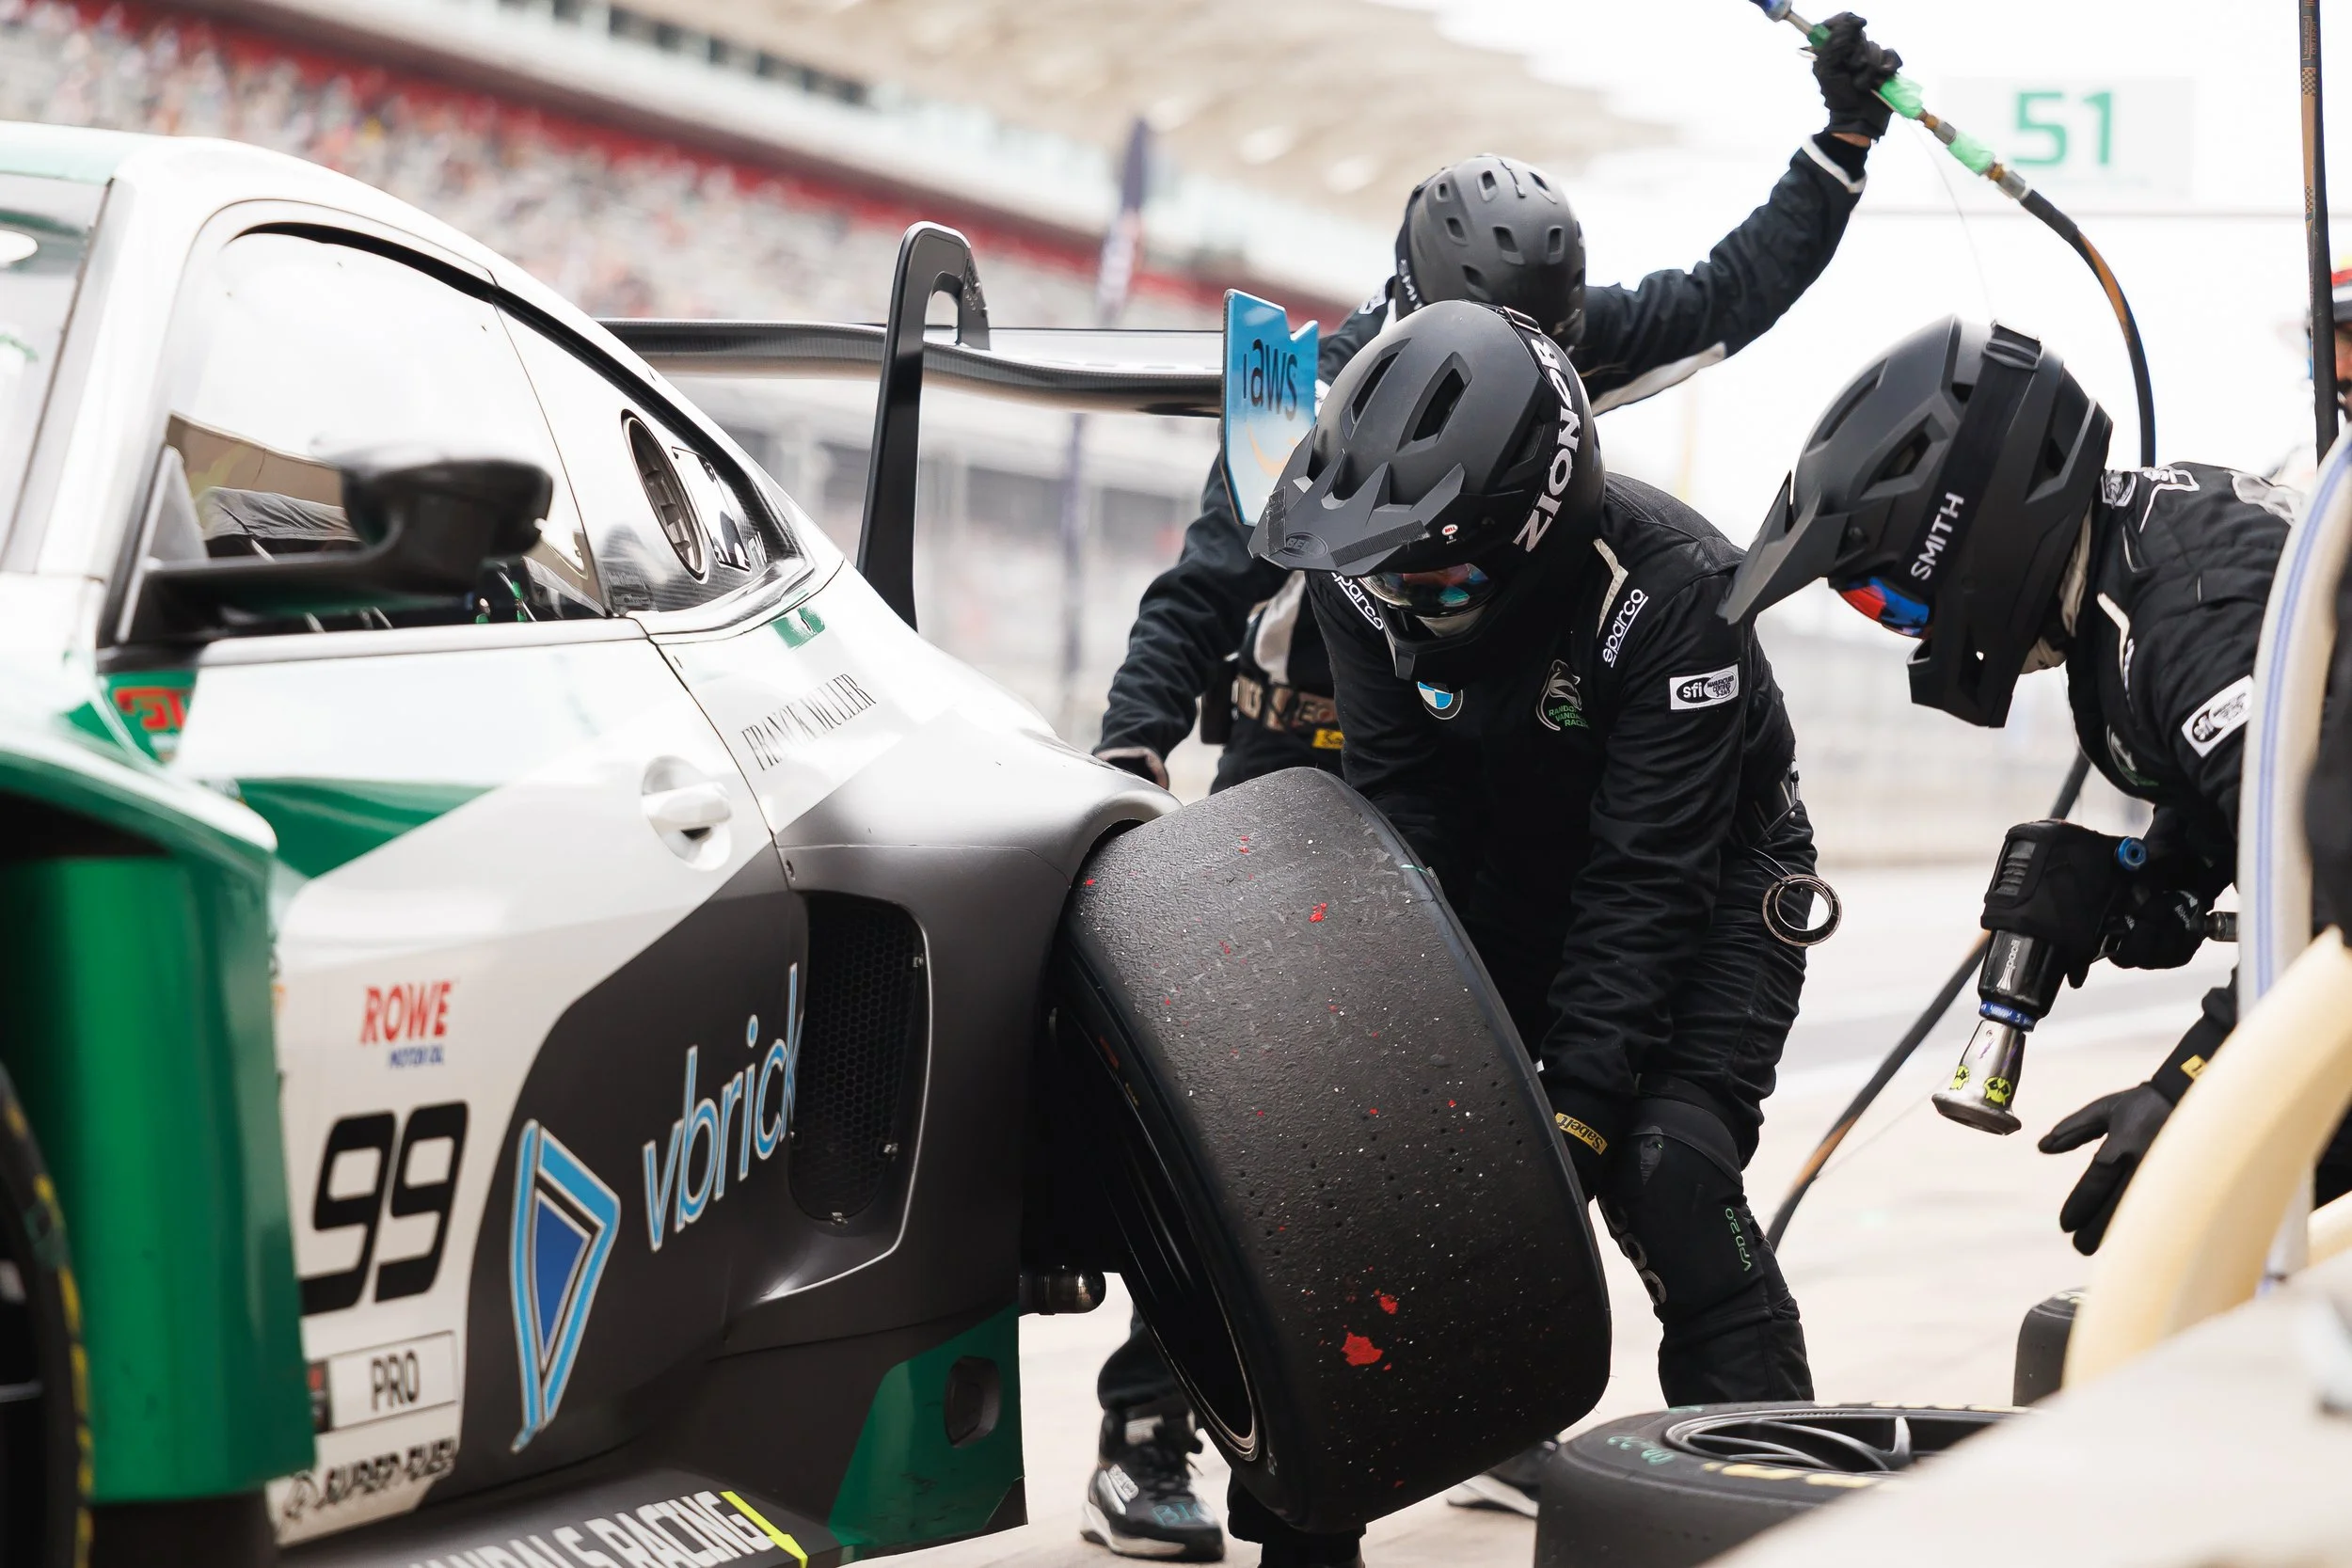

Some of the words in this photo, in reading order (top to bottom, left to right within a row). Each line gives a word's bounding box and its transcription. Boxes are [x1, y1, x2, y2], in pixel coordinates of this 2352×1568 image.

[2012, 90, 2112, 166] 51
[1250, 339, 1298, 413] aws
[1910, 492, 1964, 580] SMITH
[1602, 588, 1648, 667] sparco
[1549, 705, 1577, 716] RANDO
[1682, 682, 1703, 698] sfi
[360, 981, 451, 1044] ROWE
[643, 961, 804, 1252] vbrick
[1558, 1116, 1603, 1148] Sabelt
[299, 1100, 469, 1317] 99
[1735, 1235, 1752, 1272] VPD
[371, 1350, 420, 1411] PRO
[583, 1491, 776, 1568] RACING
